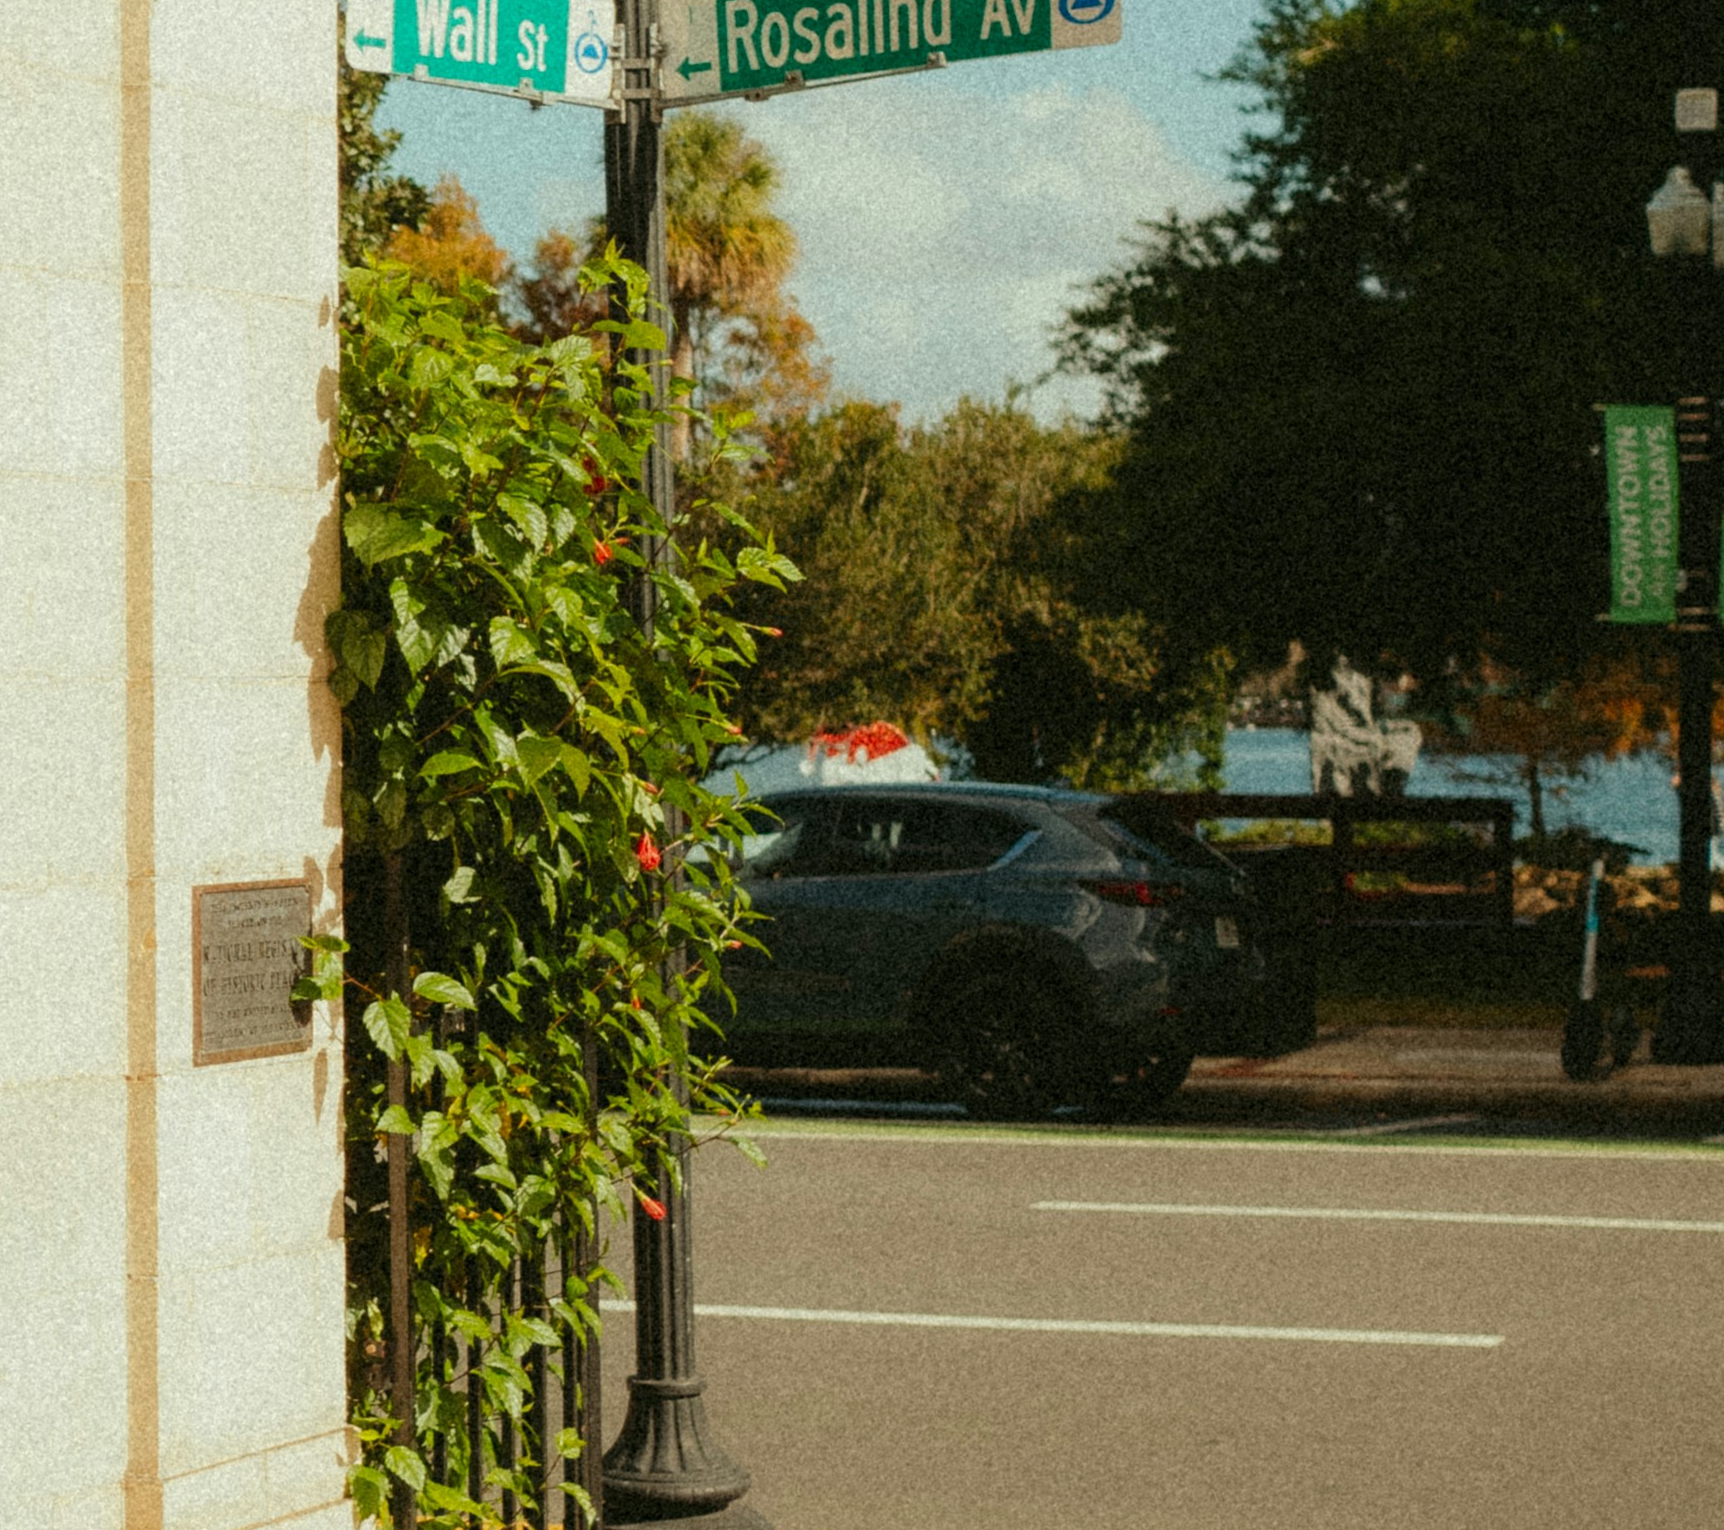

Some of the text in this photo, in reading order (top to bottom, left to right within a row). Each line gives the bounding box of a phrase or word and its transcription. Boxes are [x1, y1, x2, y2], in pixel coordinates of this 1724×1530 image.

[516, 19, 549, 72] St
[1615, 425, 1643, 607] DOWNTOWN
[1644, 424, 1672, 558] HOLIDAYS
